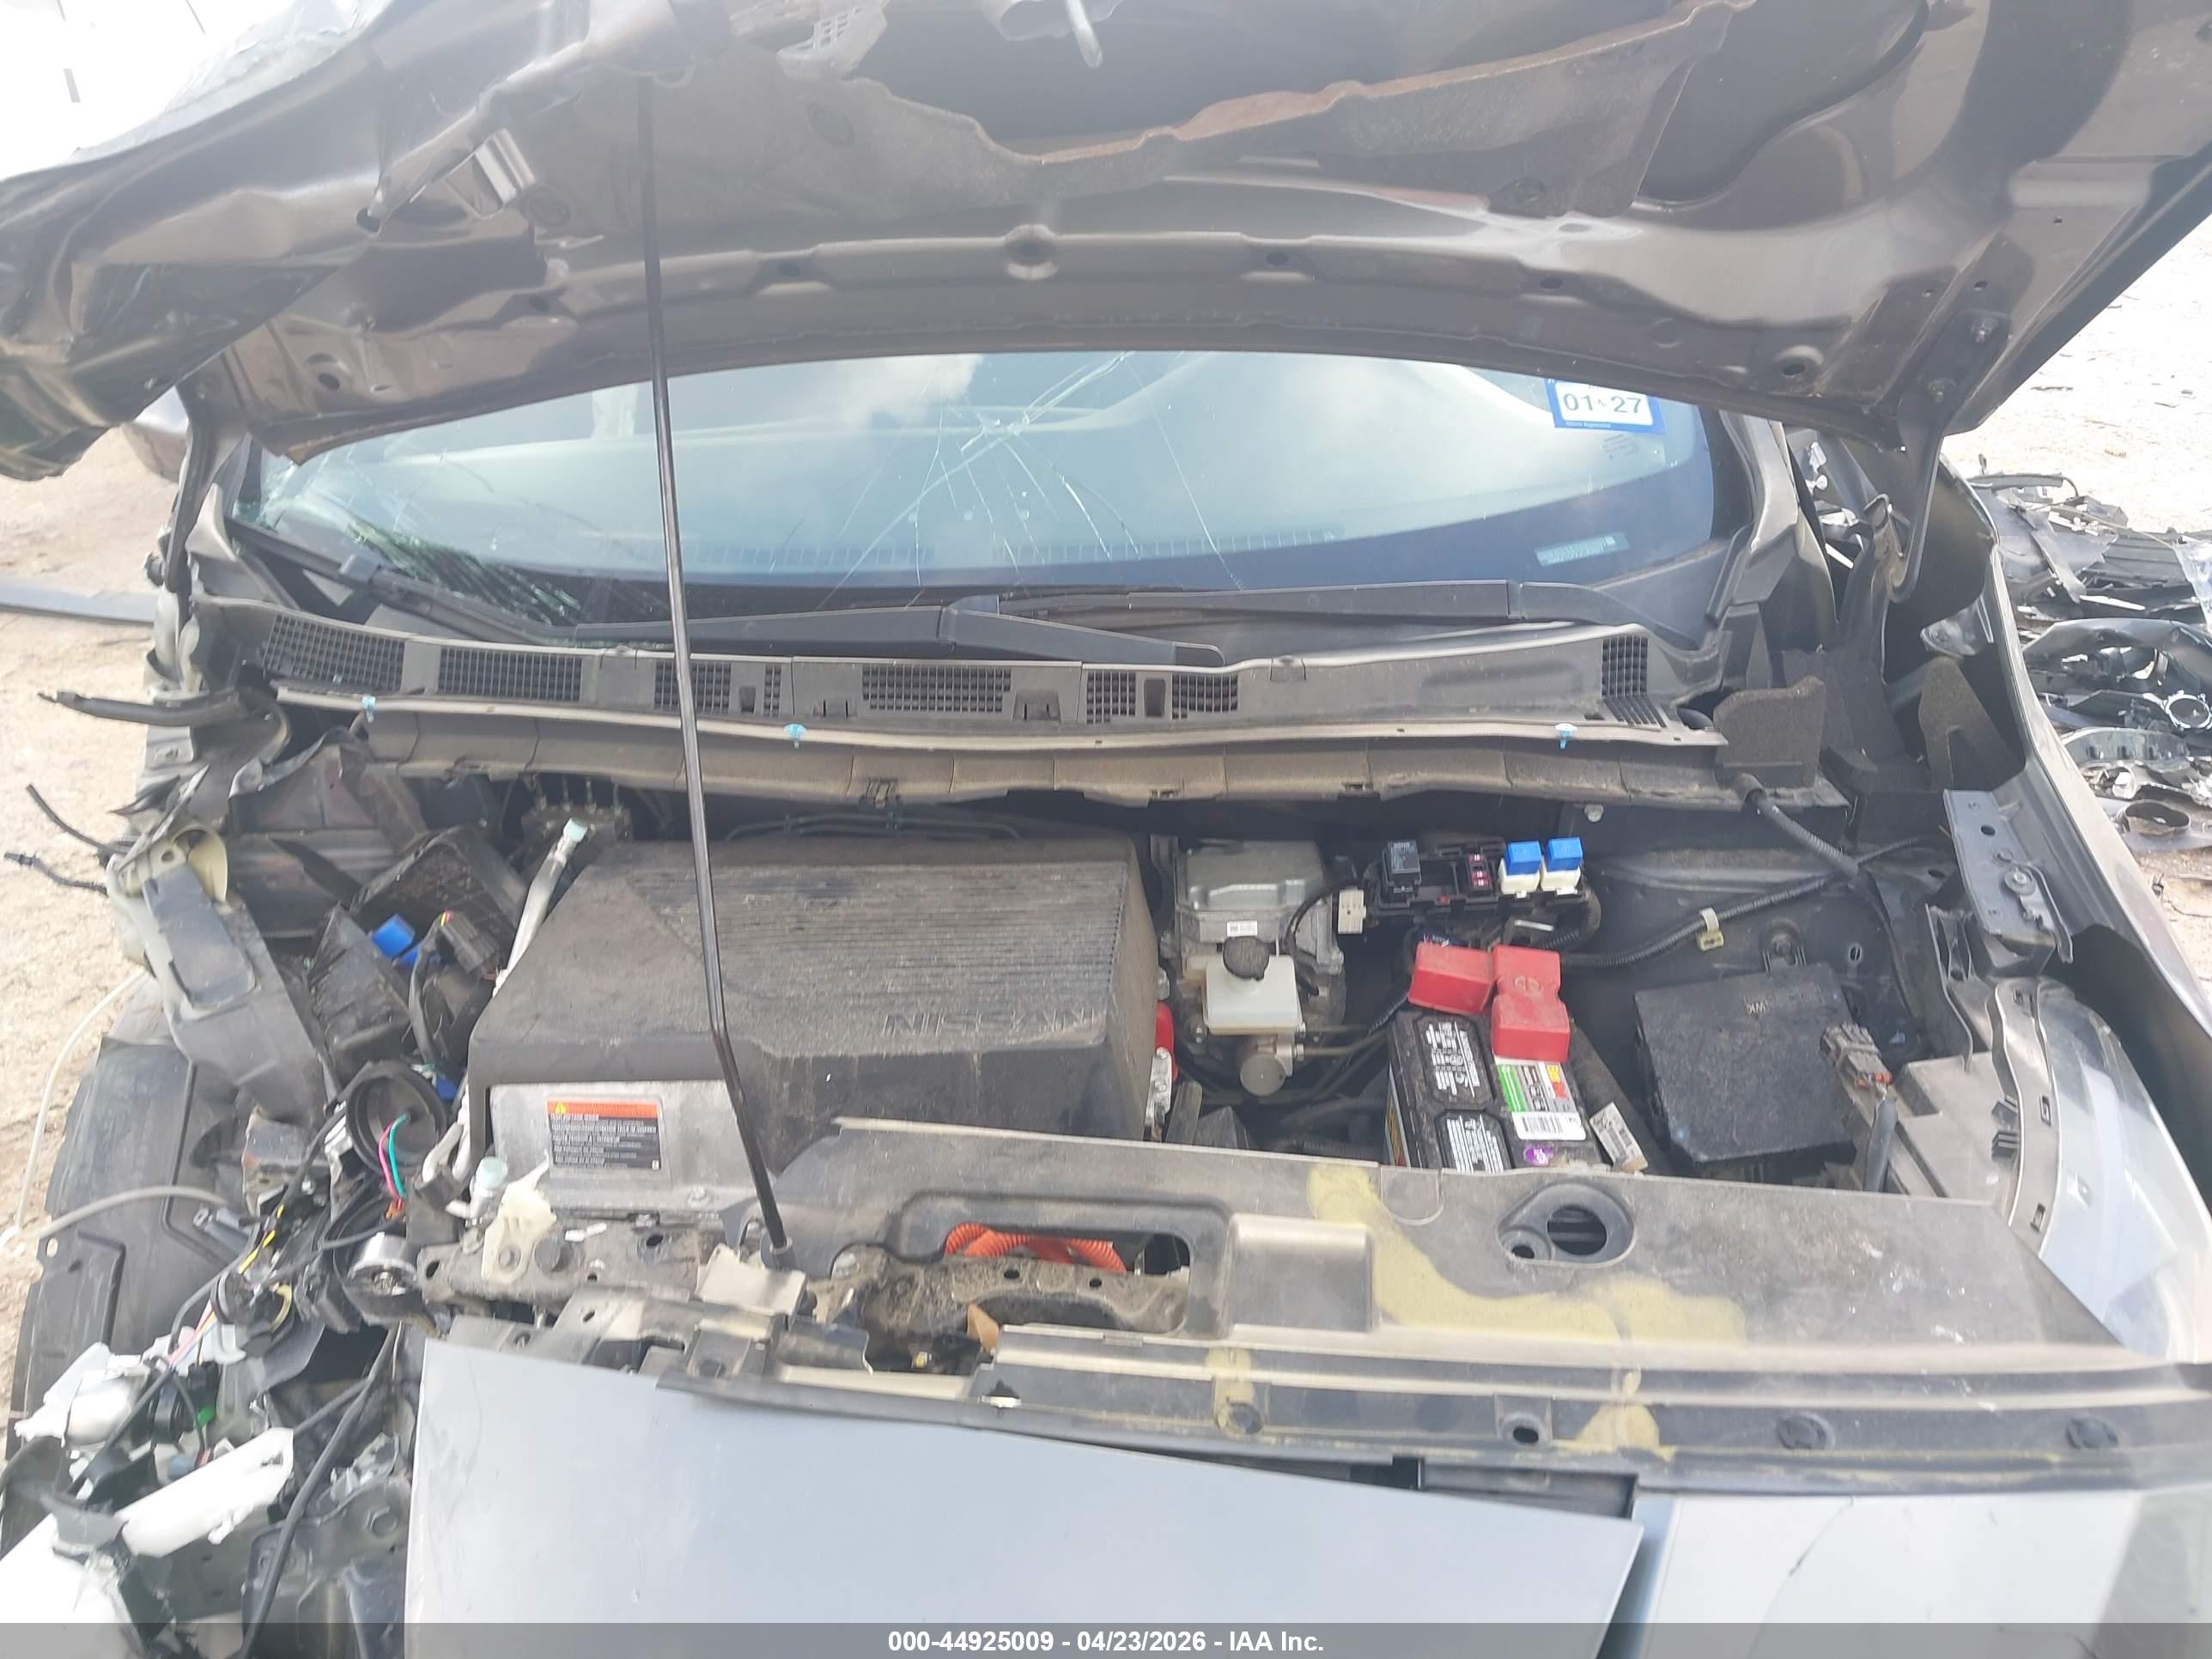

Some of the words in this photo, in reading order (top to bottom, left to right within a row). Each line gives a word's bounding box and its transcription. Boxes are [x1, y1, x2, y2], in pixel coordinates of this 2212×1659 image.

[1563, 393, 1594, 411] 01
[1611, 396, 1642, 414] 27
[882, 1008, 1096, 1038] NISSAN
